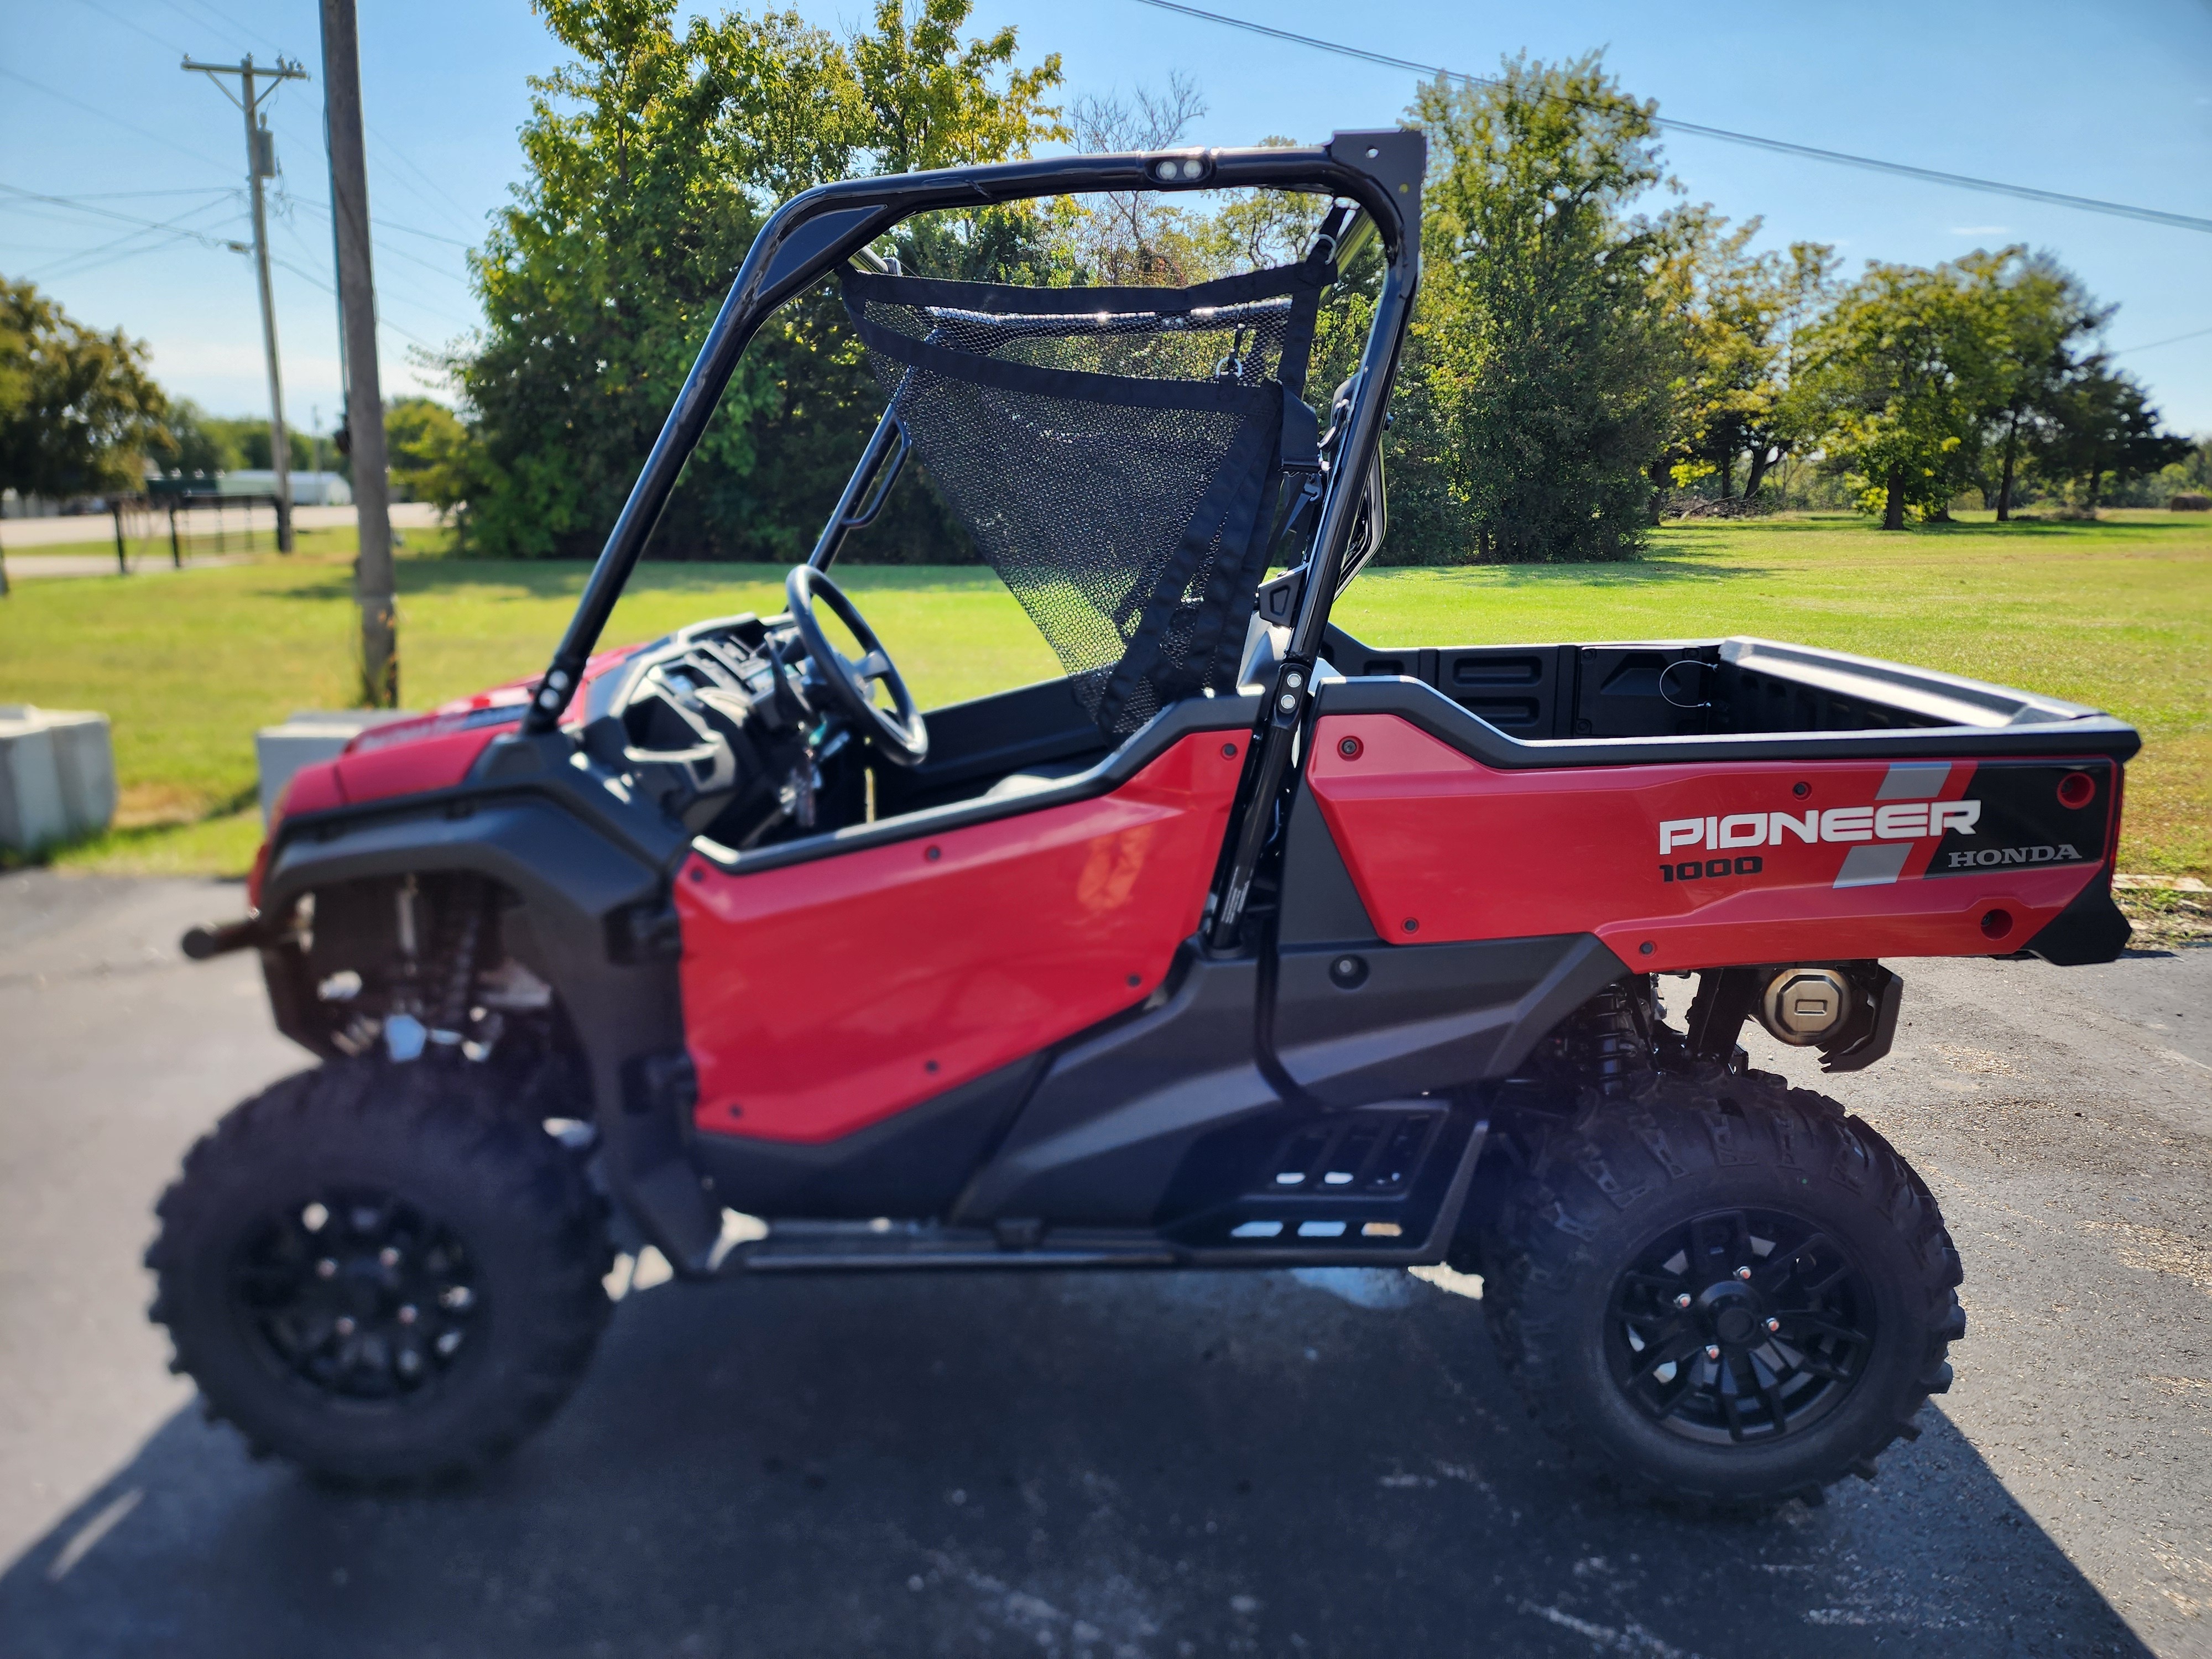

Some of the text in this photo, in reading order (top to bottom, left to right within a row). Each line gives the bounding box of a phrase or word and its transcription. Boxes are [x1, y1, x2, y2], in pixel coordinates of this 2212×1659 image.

[1660, 800, 1981, 854] PIONEER
[1659, 855, 1763, 883] 1000
[1948, 844, 2082, 868] HONDA
